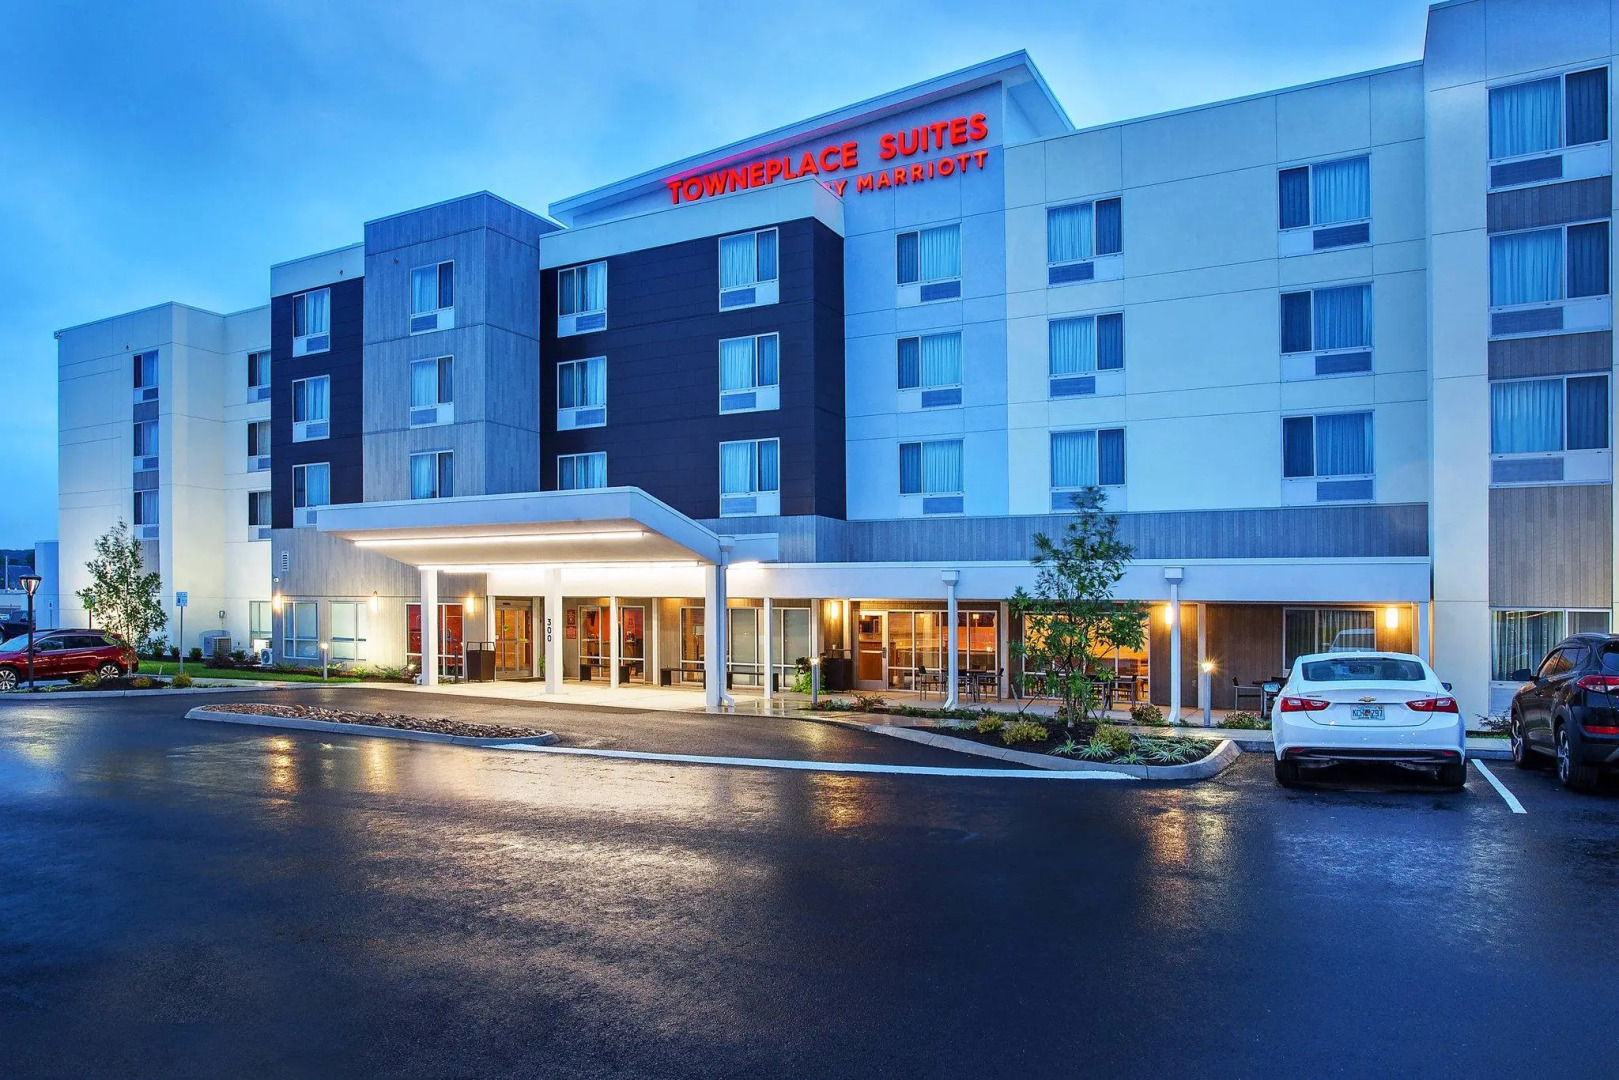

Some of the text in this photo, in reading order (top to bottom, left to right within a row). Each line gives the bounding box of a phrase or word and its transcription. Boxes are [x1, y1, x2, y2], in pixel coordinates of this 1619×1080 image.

[667, 112, 988, 204] TOWNEPLACE SUITES
[857, 150, 988, 193] MARRIOTT
